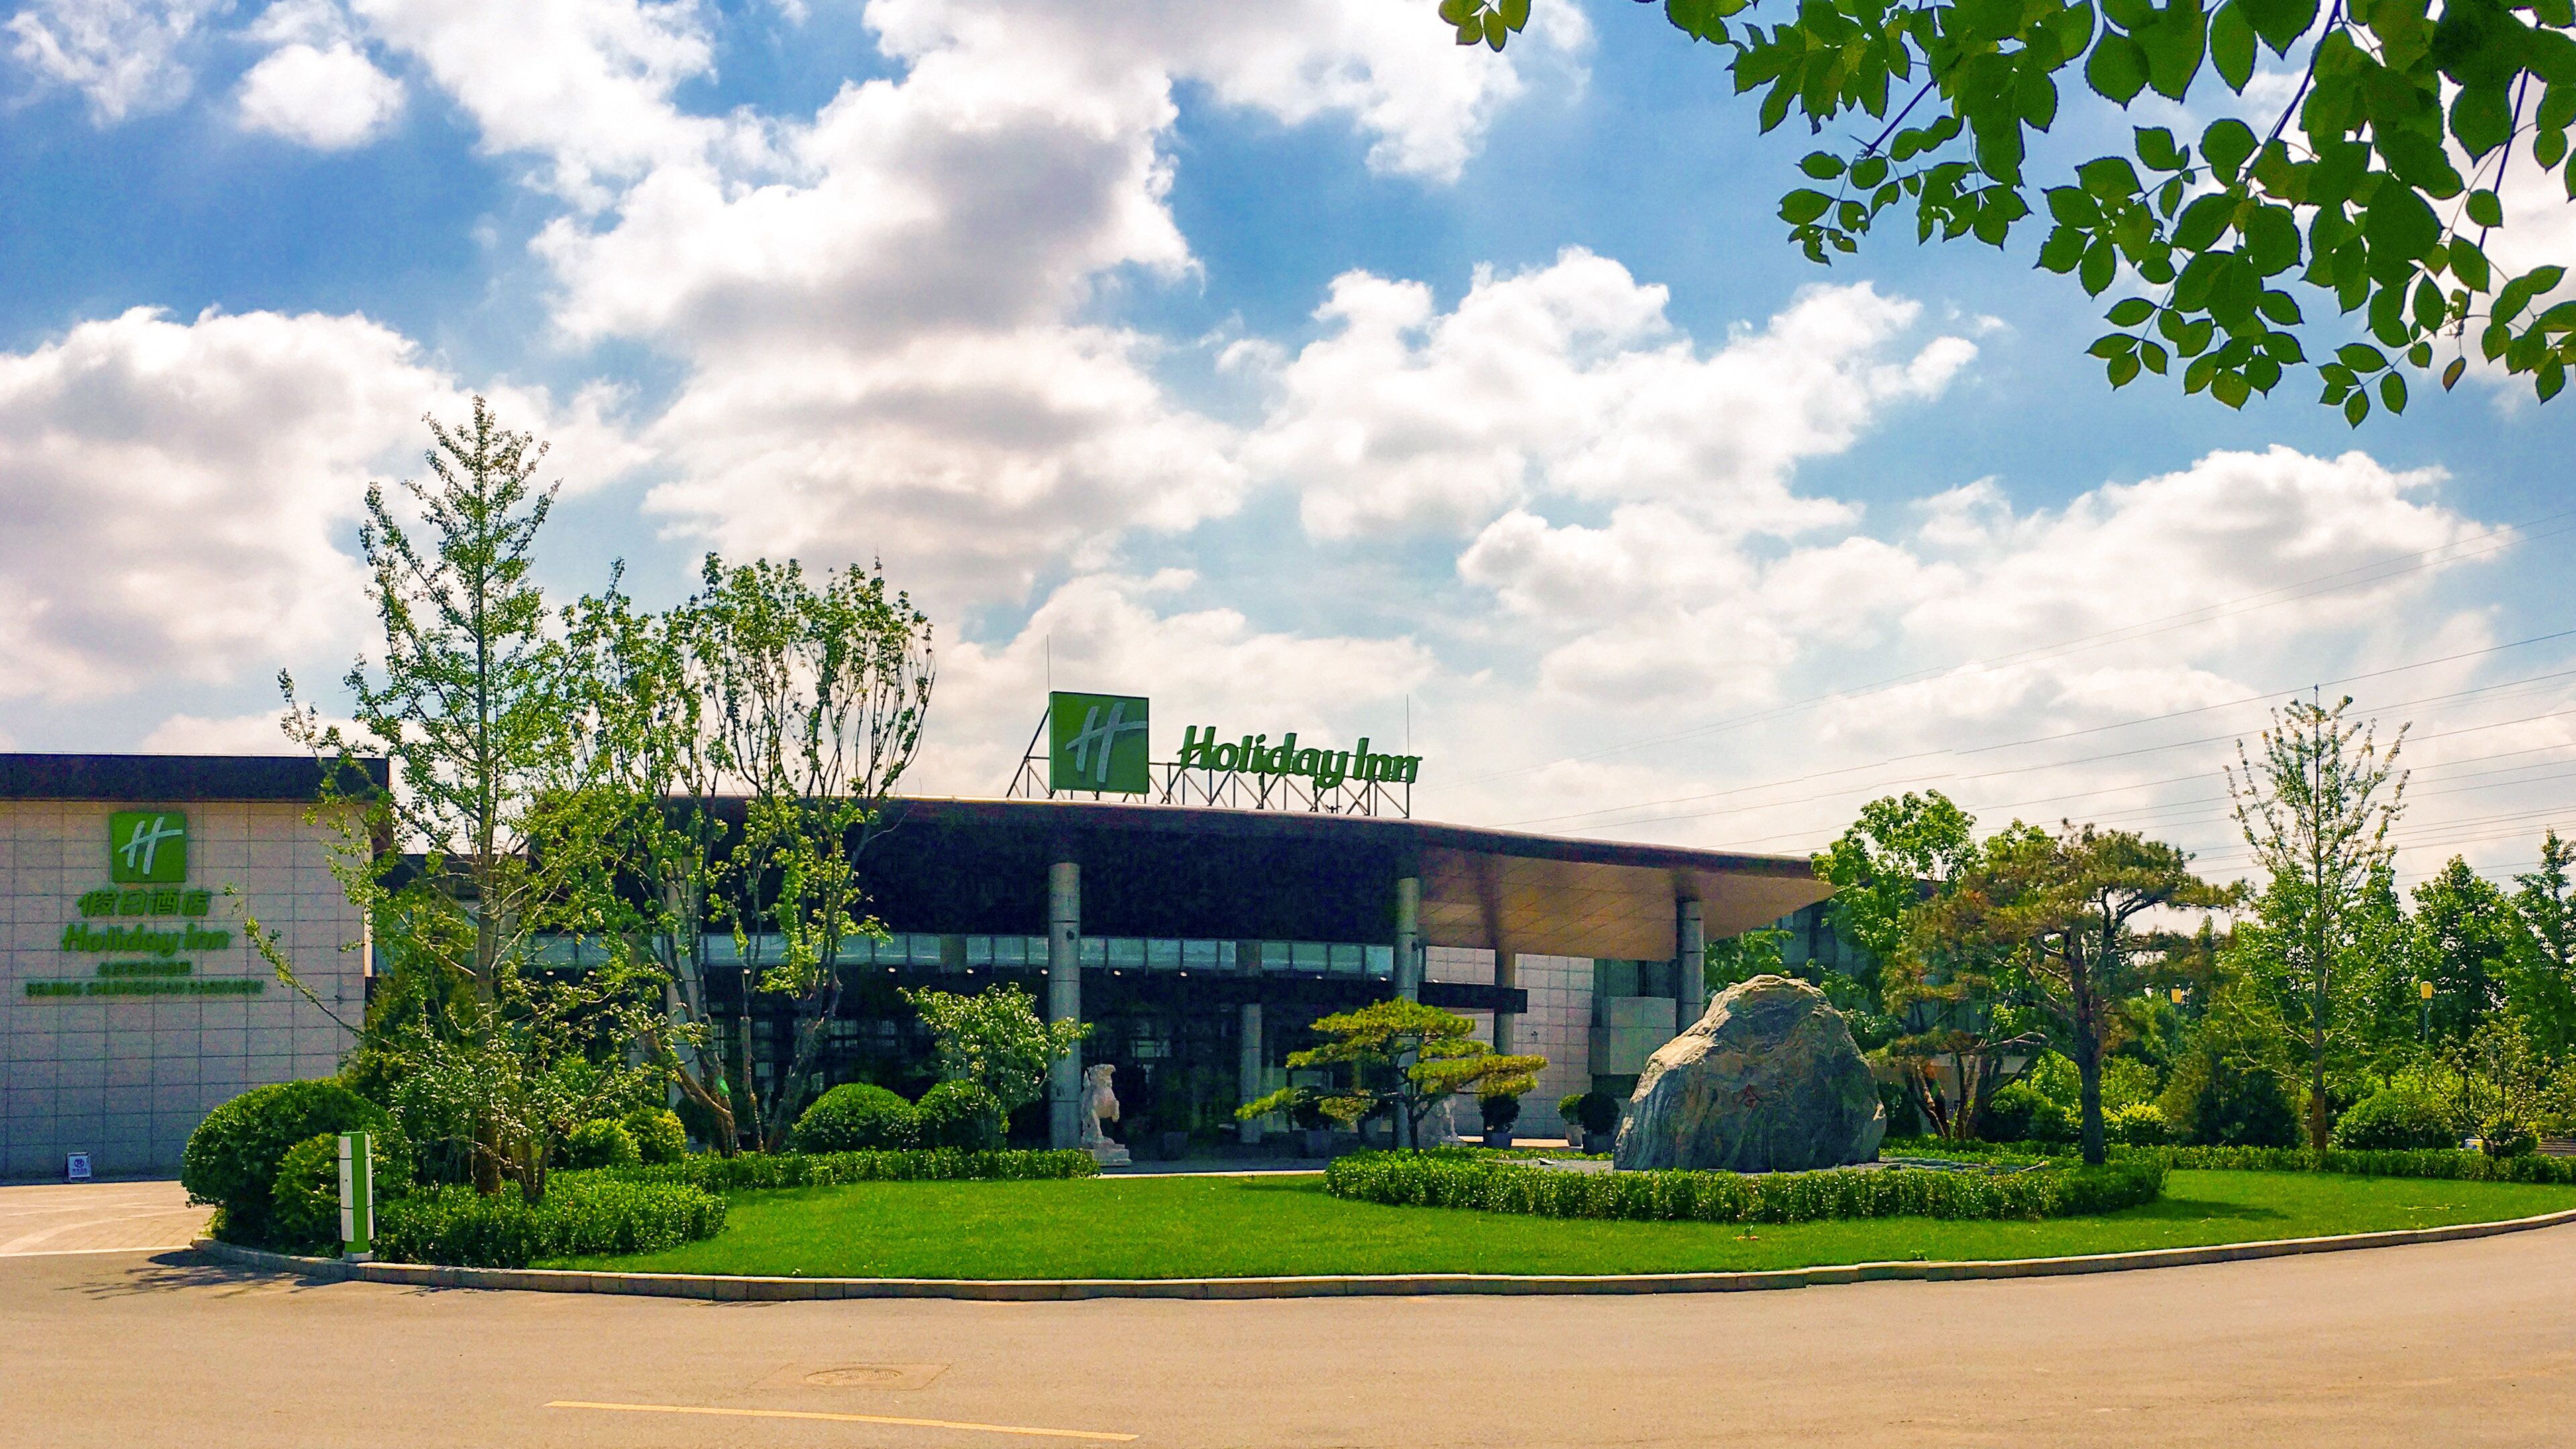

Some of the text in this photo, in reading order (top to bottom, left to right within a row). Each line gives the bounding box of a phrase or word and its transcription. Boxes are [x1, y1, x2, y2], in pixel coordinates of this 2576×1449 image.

[1177, 725, 1423, 790] Holiday Inn
[76, 890, 210, 917] 假日酒店
[62, 922, 231, 957] Holiday Inn
